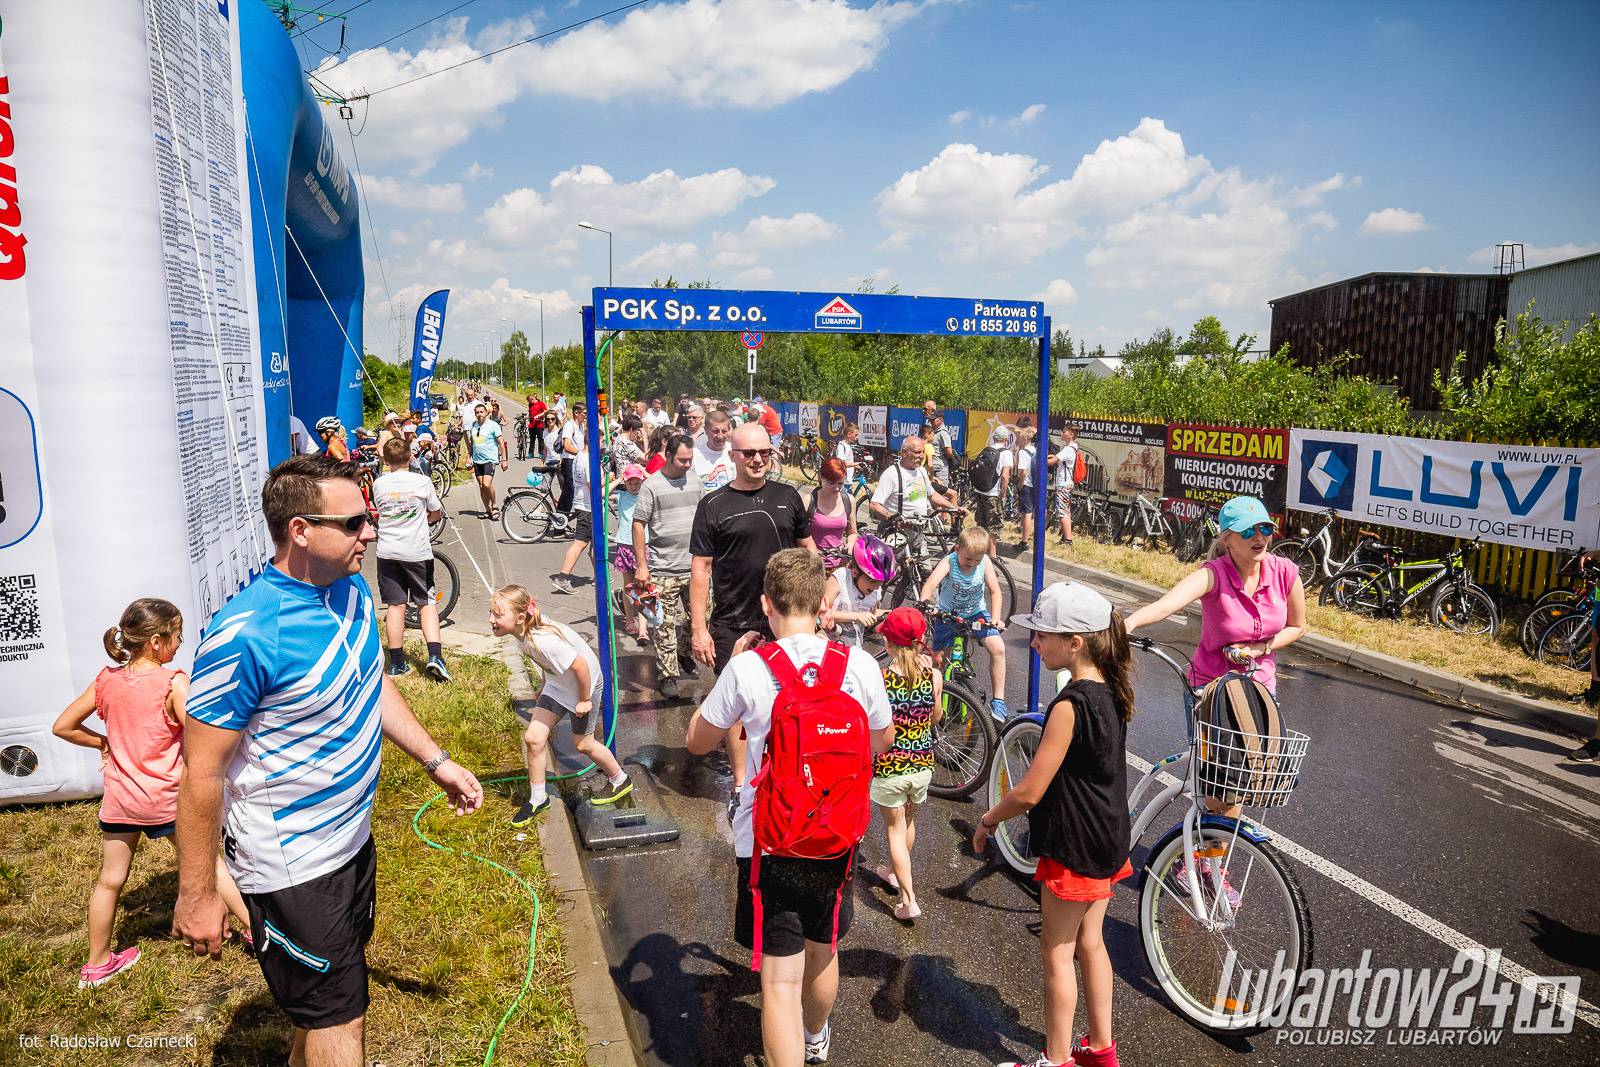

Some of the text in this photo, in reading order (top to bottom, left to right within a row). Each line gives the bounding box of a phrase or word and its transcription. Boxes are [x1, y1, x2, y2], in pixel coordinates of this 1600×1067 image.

[603, 298, 767, 324] PGK Sp. z o.o.
[974, 303, 1037, 318] Parkowa 6
[821, 316, 857, 326] LUBARTÓW
[963, 318, 1037, 333] 81 855 20 96
[420, 307, 441, 370] MAPEI
[900, 422, 920, 437] MAPEI
[1171, 428, 1284, 460] SPRZEDAM
[1497, 450, 1582, 465] WWW.LUVI.PL
[1174, 457, 1276, 481] NIERUCHOMOŚĆ
[1181, 472, 1264, 498] KOMERCYJNĄ
[1369, 449, 1583, 522] LUVI
[1171, 501, 1185, 516] 662
[1366, 503, 1574, 546] LET'S BUILD TOGETHER
[817, 727, 849, 735] V-Power
